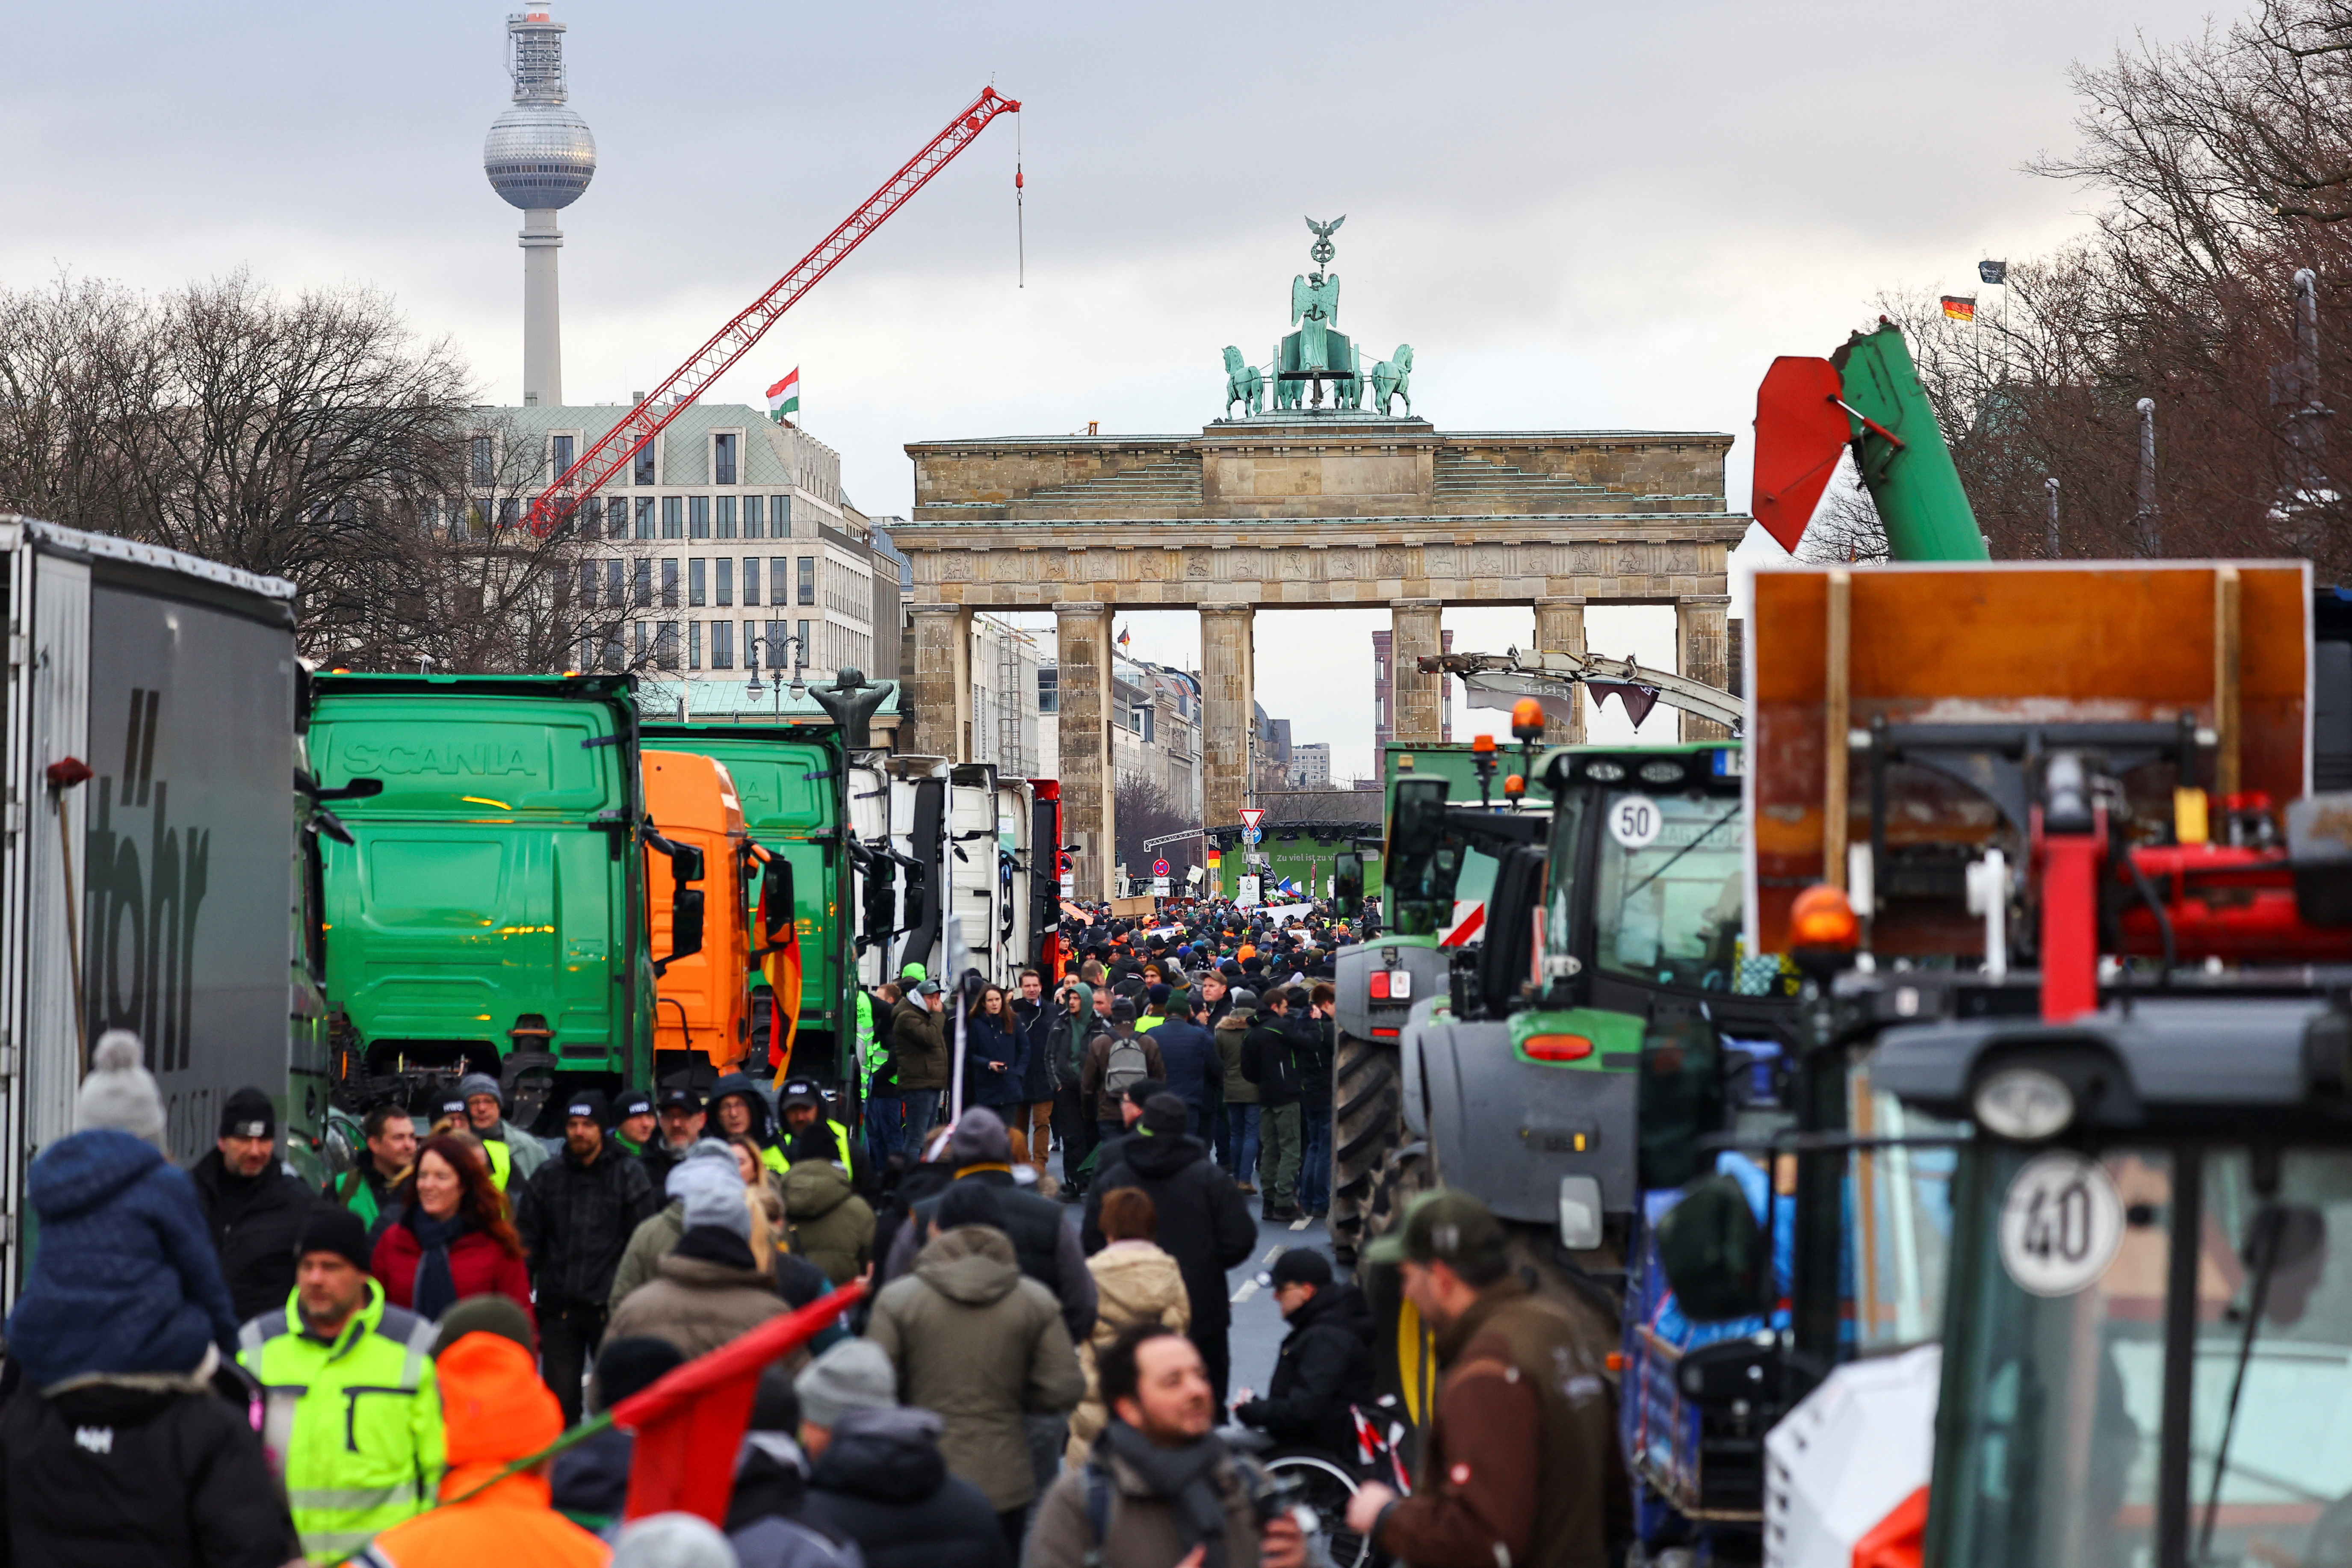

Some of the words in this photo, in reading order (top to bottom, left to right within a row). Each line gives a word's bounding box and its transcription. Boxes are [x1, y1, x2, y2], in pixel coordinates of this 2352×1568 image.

[343, 742, 536, 776] SCANIA
[1622, 806, 1649, 837] 50
[1289, 853, 1304, 861] viel
[2023, 1180, 2090, 1263] 40
